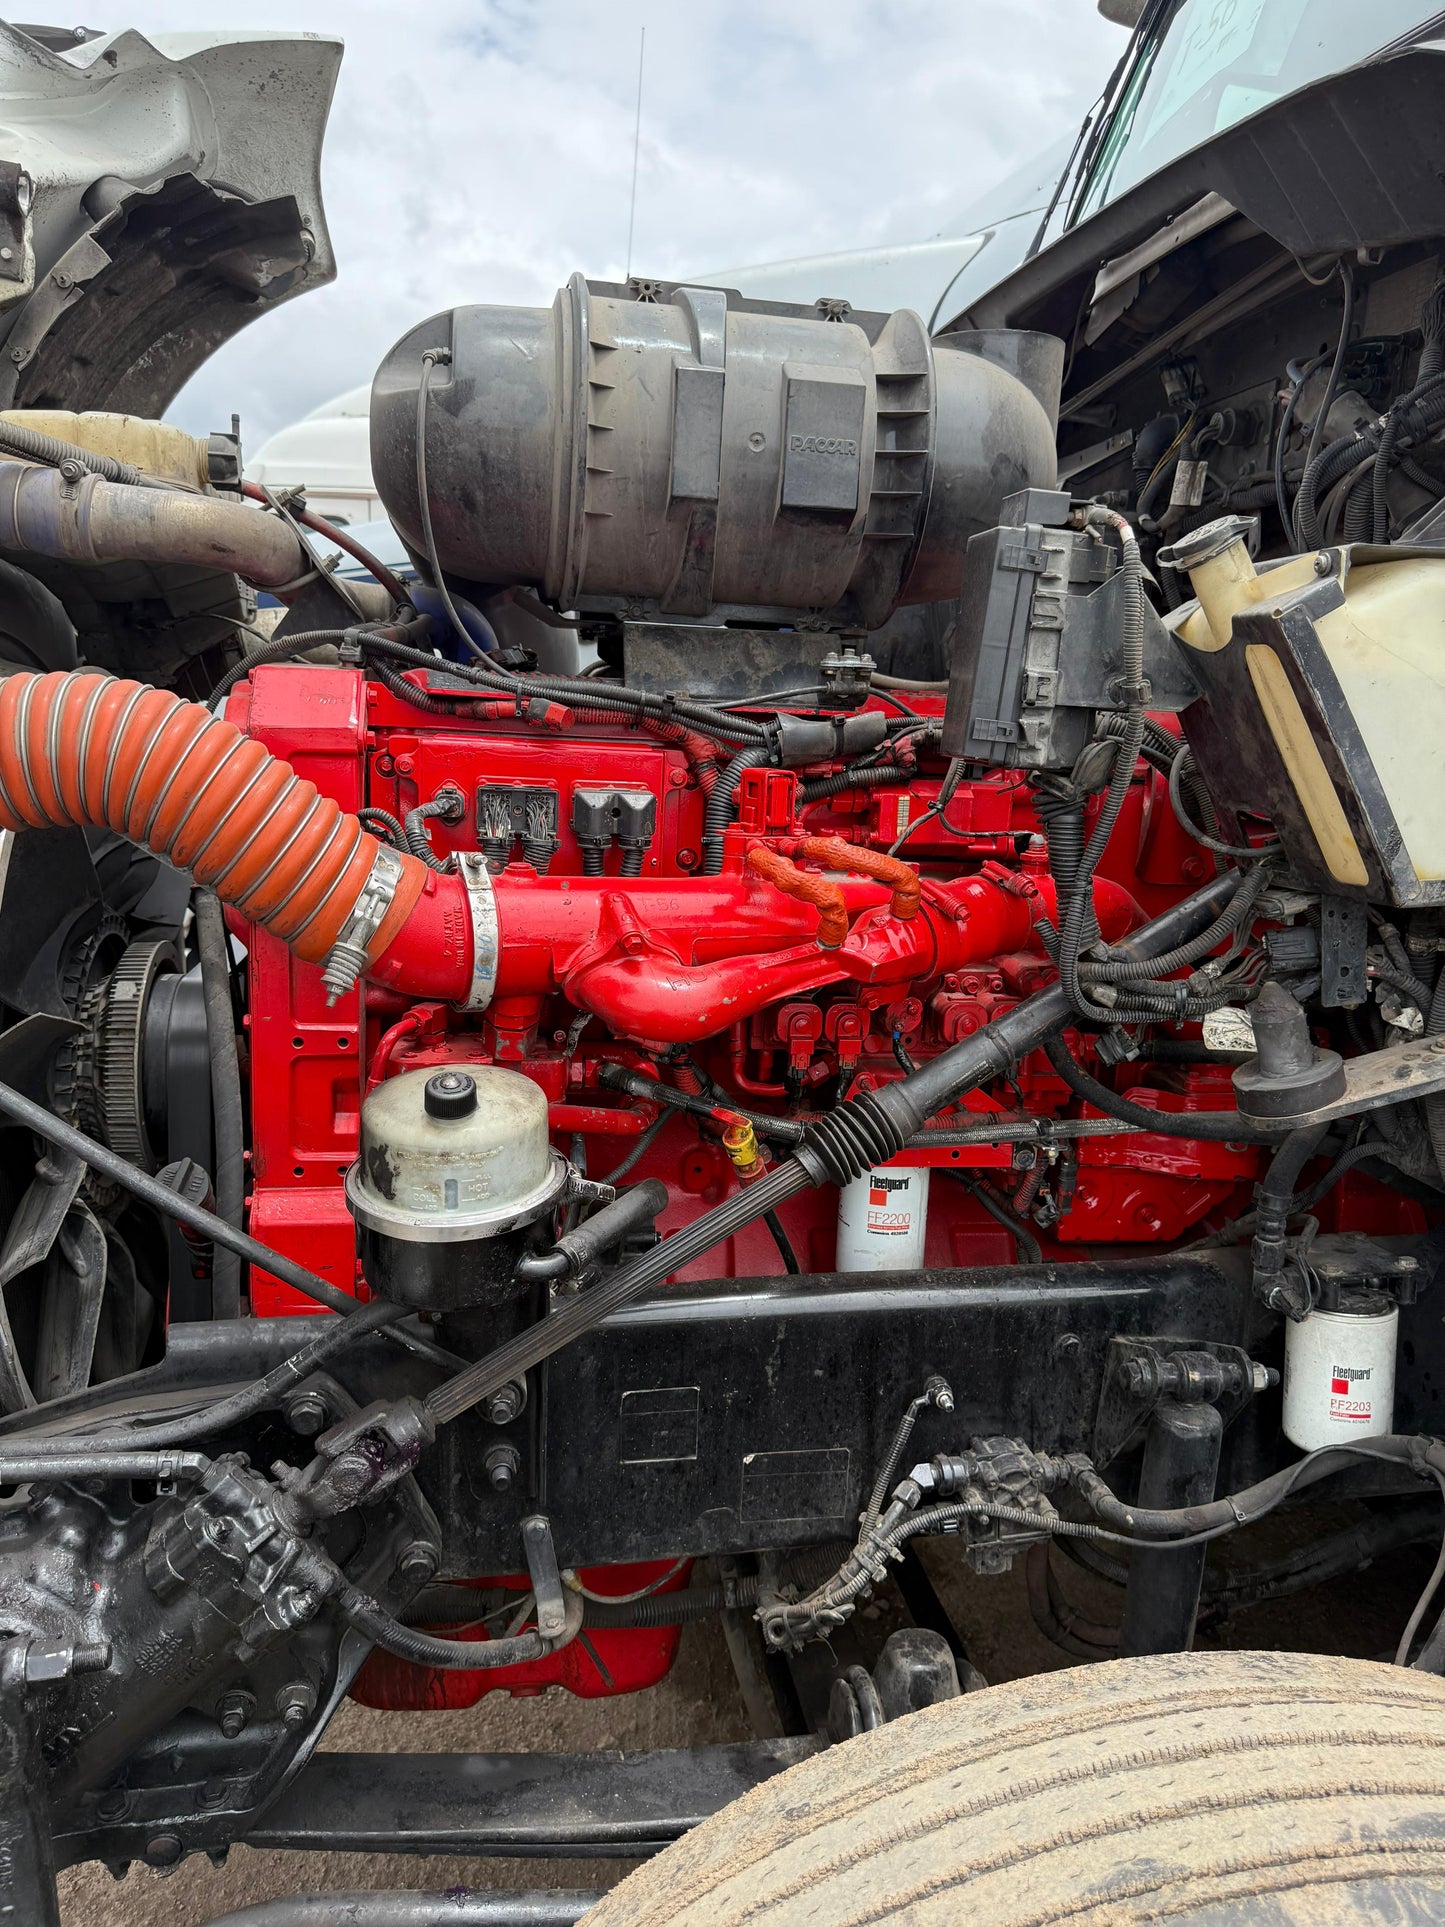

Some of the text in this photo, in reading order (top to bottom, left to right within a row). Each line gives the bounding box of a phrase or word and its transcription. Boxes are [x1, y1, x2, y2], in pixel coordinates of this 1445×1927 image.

[791, 434, 857, 456] PACCAR
[468, 1182, 489, 1192] HOT
[870, 1174, 909, 1192] Fleetguard
[413, 1193, 438, 1203] COLD
[867, 1210, 911, 1225] FF2200
[1332, 1365, 1371, 1382] Fleetguard
